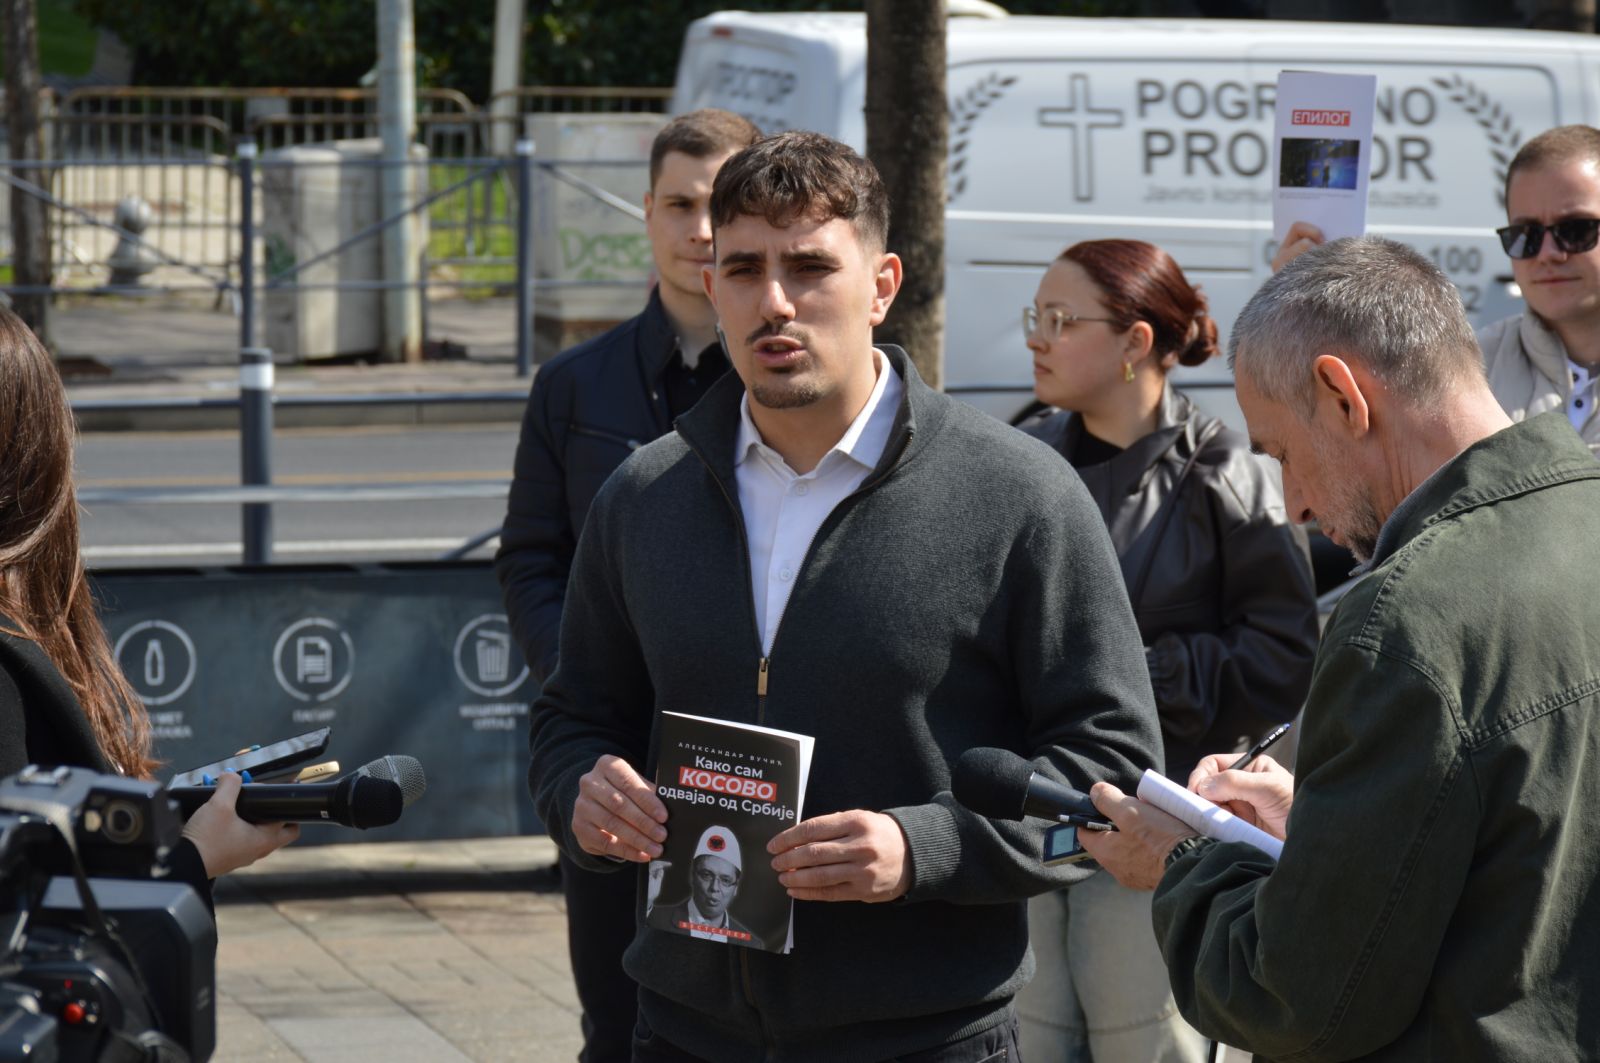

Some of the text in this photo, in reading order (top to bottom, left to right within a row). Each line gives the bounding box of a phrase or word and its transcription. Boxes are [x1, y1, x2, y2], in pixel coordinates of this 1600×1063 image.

[1136, 79, 1436, 126] POGRNO
[1293, 111, 1349, 125] ЕПИЛОГ
[1143, 130, 1436, 181] PROOR
[678, 742, 744, 758] АЛЕКСАНДАР
[695, 755, 763, 779] Како сам
[681, 769, 773, 799] КОСОВО
[658, 786, 795, 820] одвајао од Србије
